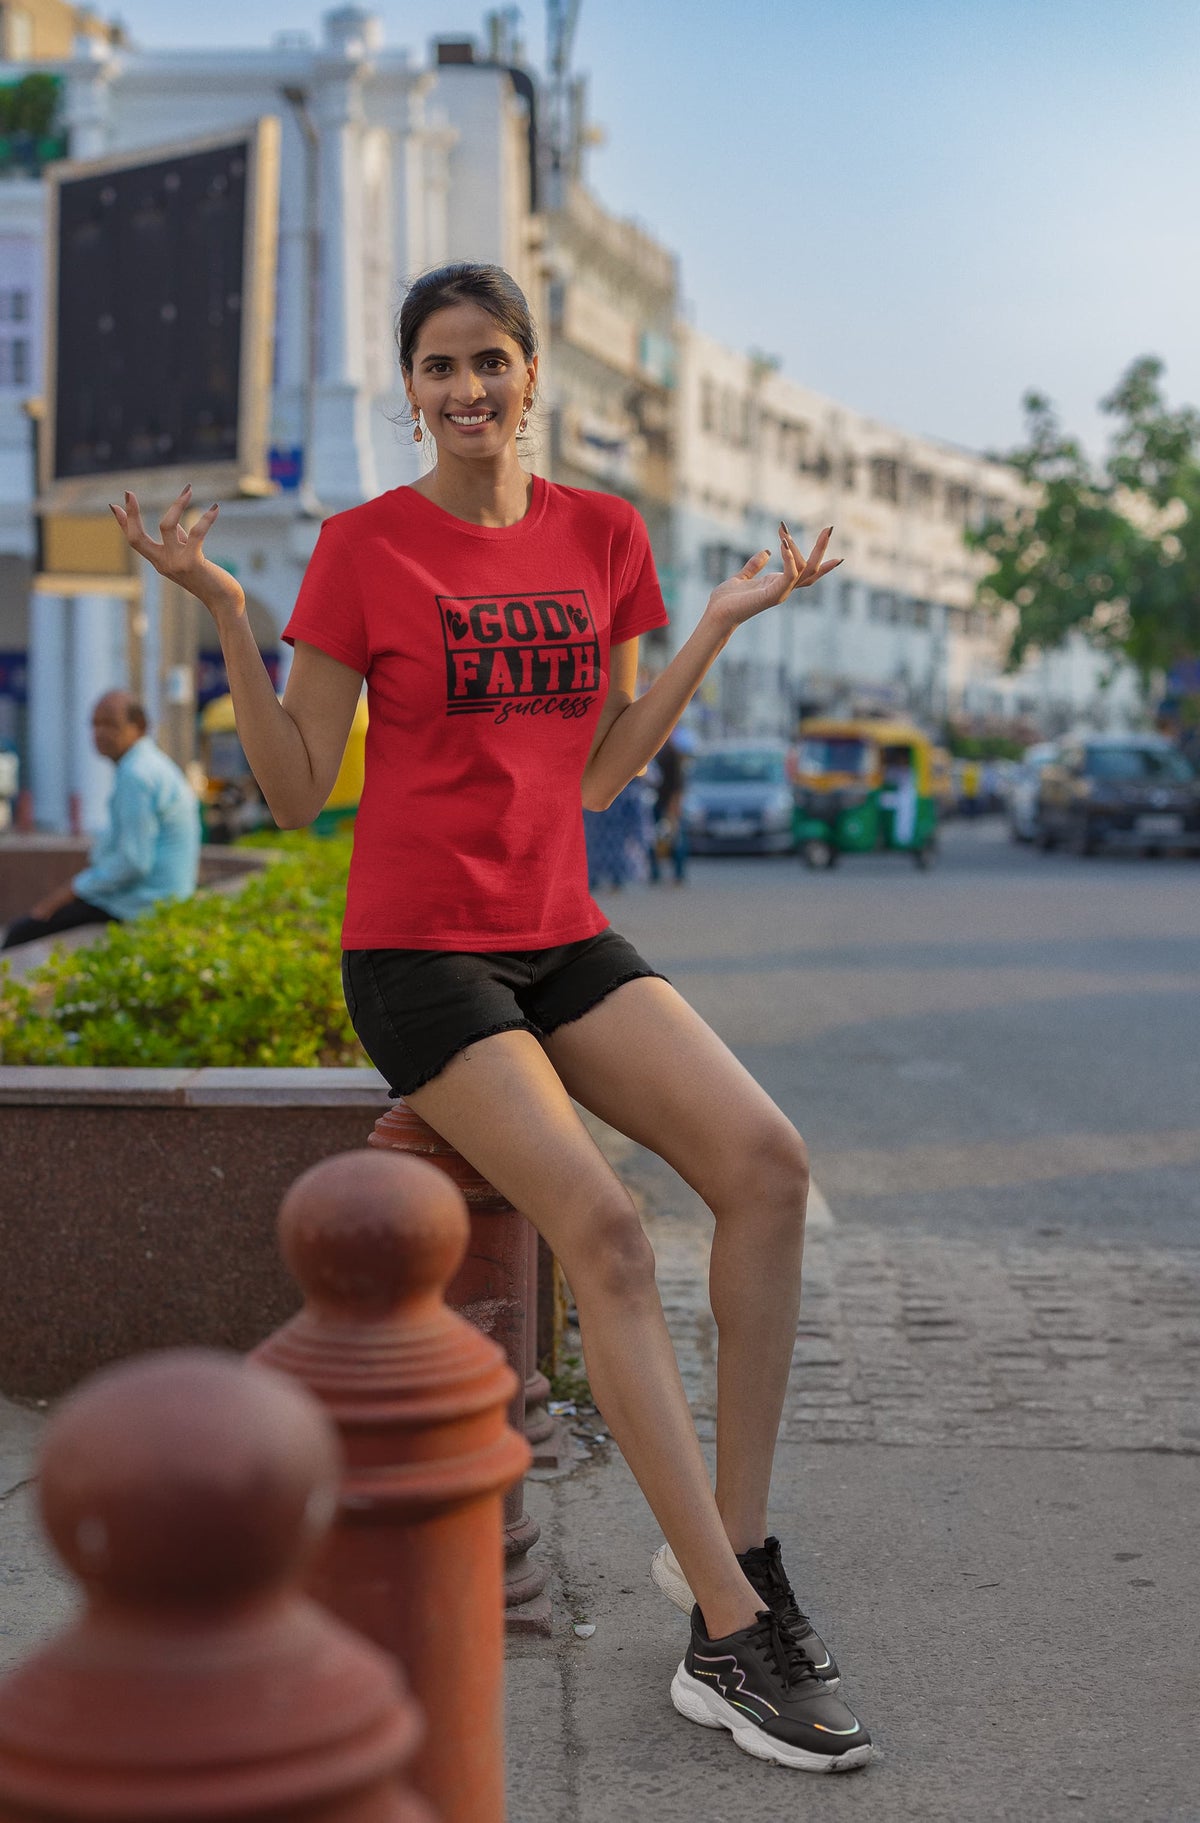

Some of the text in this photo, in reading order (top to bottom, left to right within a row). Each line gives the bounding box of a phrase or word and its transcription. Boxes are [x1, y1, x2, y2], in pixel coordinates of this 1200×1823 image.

[469, 600, 571, 643] GOD
[452, 645, 595, 697] FAITH
[494, 695, 597, 725] success
